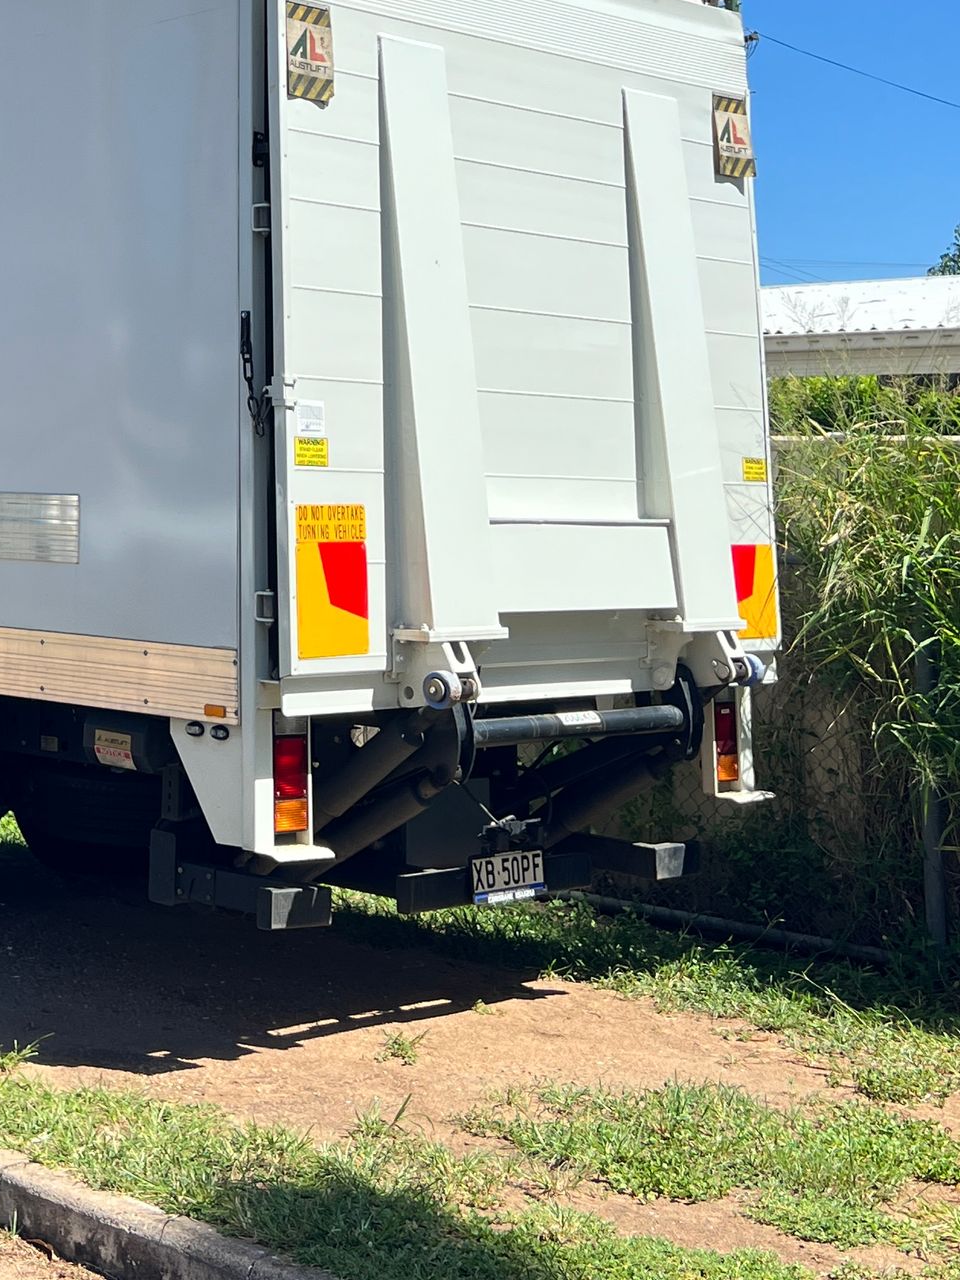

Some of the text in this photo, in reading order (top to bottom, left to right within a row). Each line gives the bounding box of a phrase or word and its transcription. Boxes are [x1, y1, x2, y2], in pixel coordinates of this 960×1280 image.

[299, 505, 364, 521] DO NOT OVERTAKE
[298, 524, 364, 540] TURNING VEHICLE
